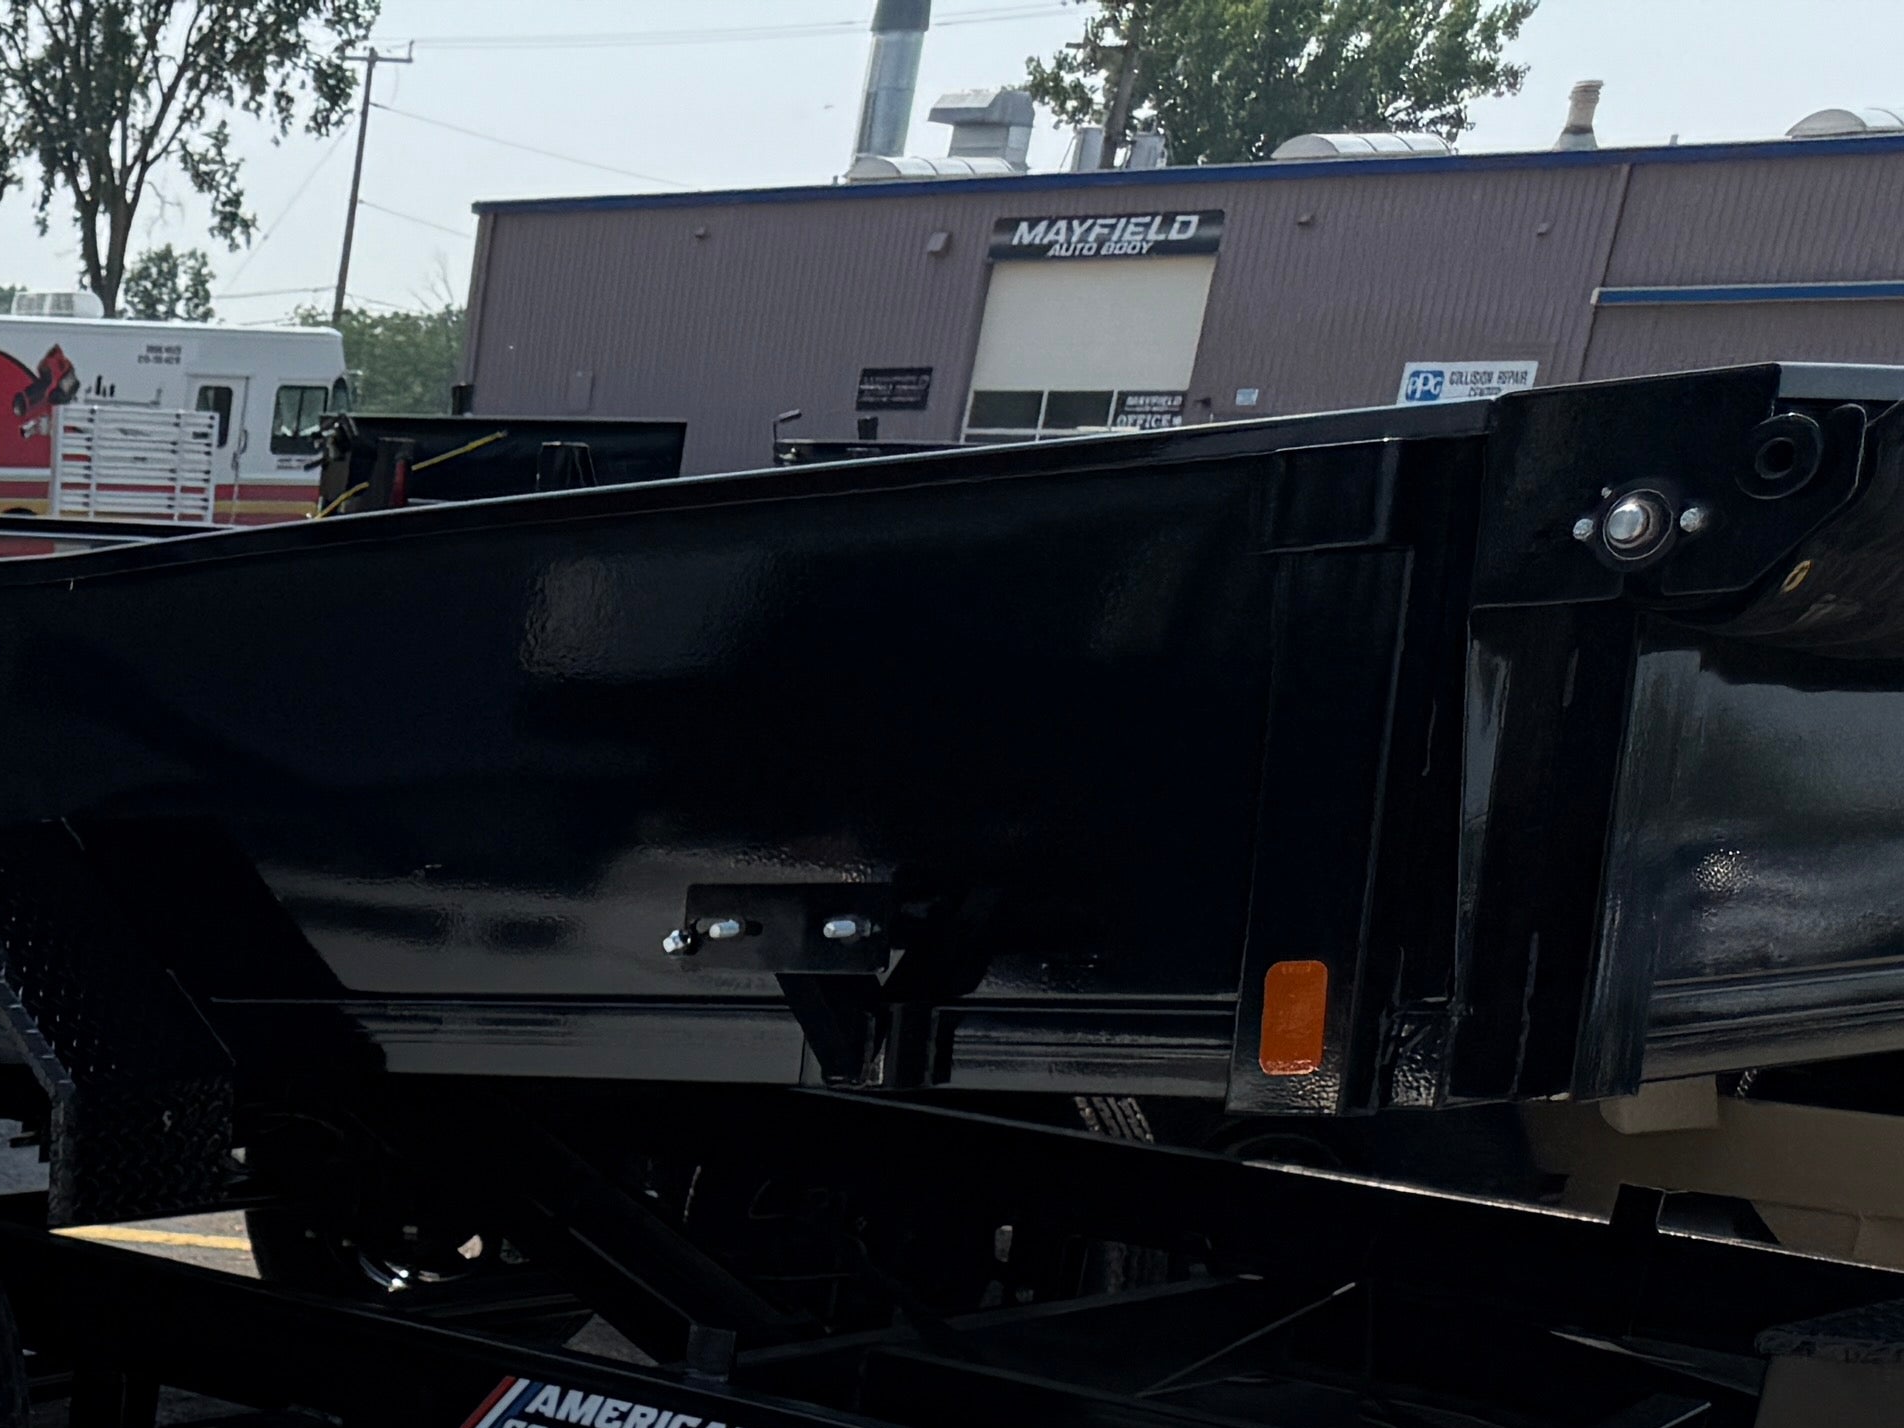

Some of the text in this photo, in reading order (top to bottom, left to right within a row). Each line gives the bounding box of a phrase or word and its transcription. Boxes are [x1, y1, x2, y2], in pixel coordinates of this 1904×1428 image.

[1012, 215, 1200, 245] MAYFIELD
[1047, 241, 1154, 257] AUTO BODY
[1407, 372, 1442, 399] PPG
[1116, 413, 1171, 428] OFFICE
